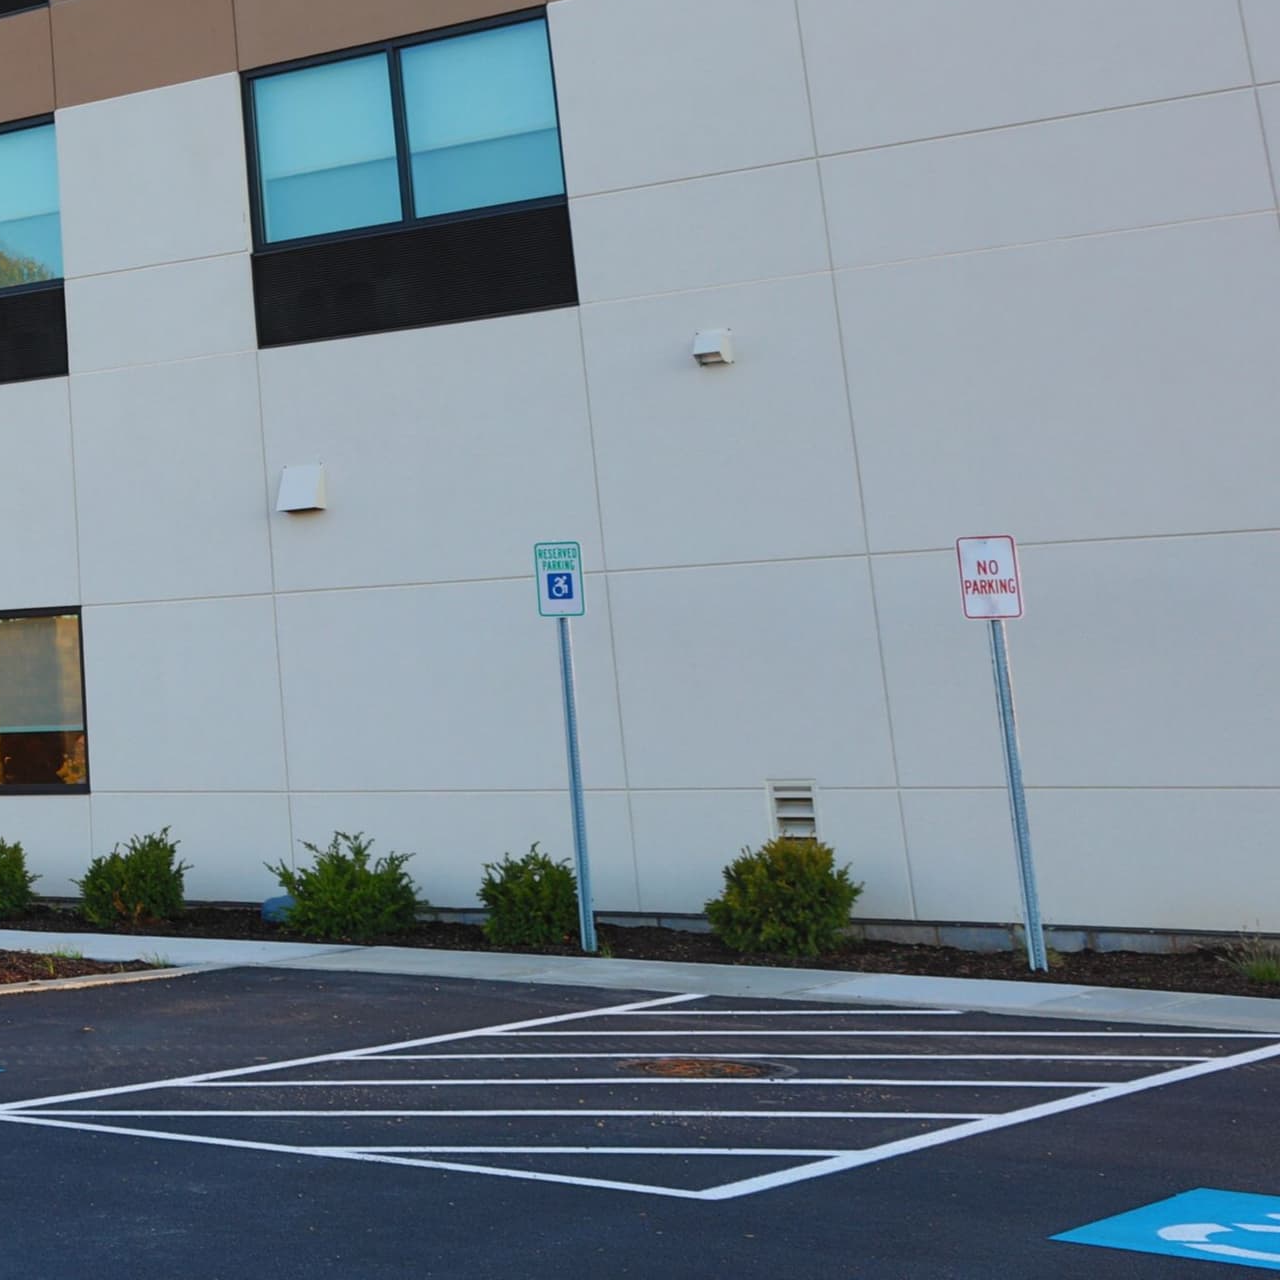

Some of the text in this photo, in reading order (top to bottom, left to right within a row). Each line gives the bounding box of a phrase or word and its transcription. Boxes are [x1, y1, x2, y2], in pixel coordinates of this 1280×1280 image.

[537, 548, 577, 559] RESERVED
[542, 560, 576, 571] PARKING
[976, 559, 999, 575] NO
[964, 578, 1017, 595] PARKING
